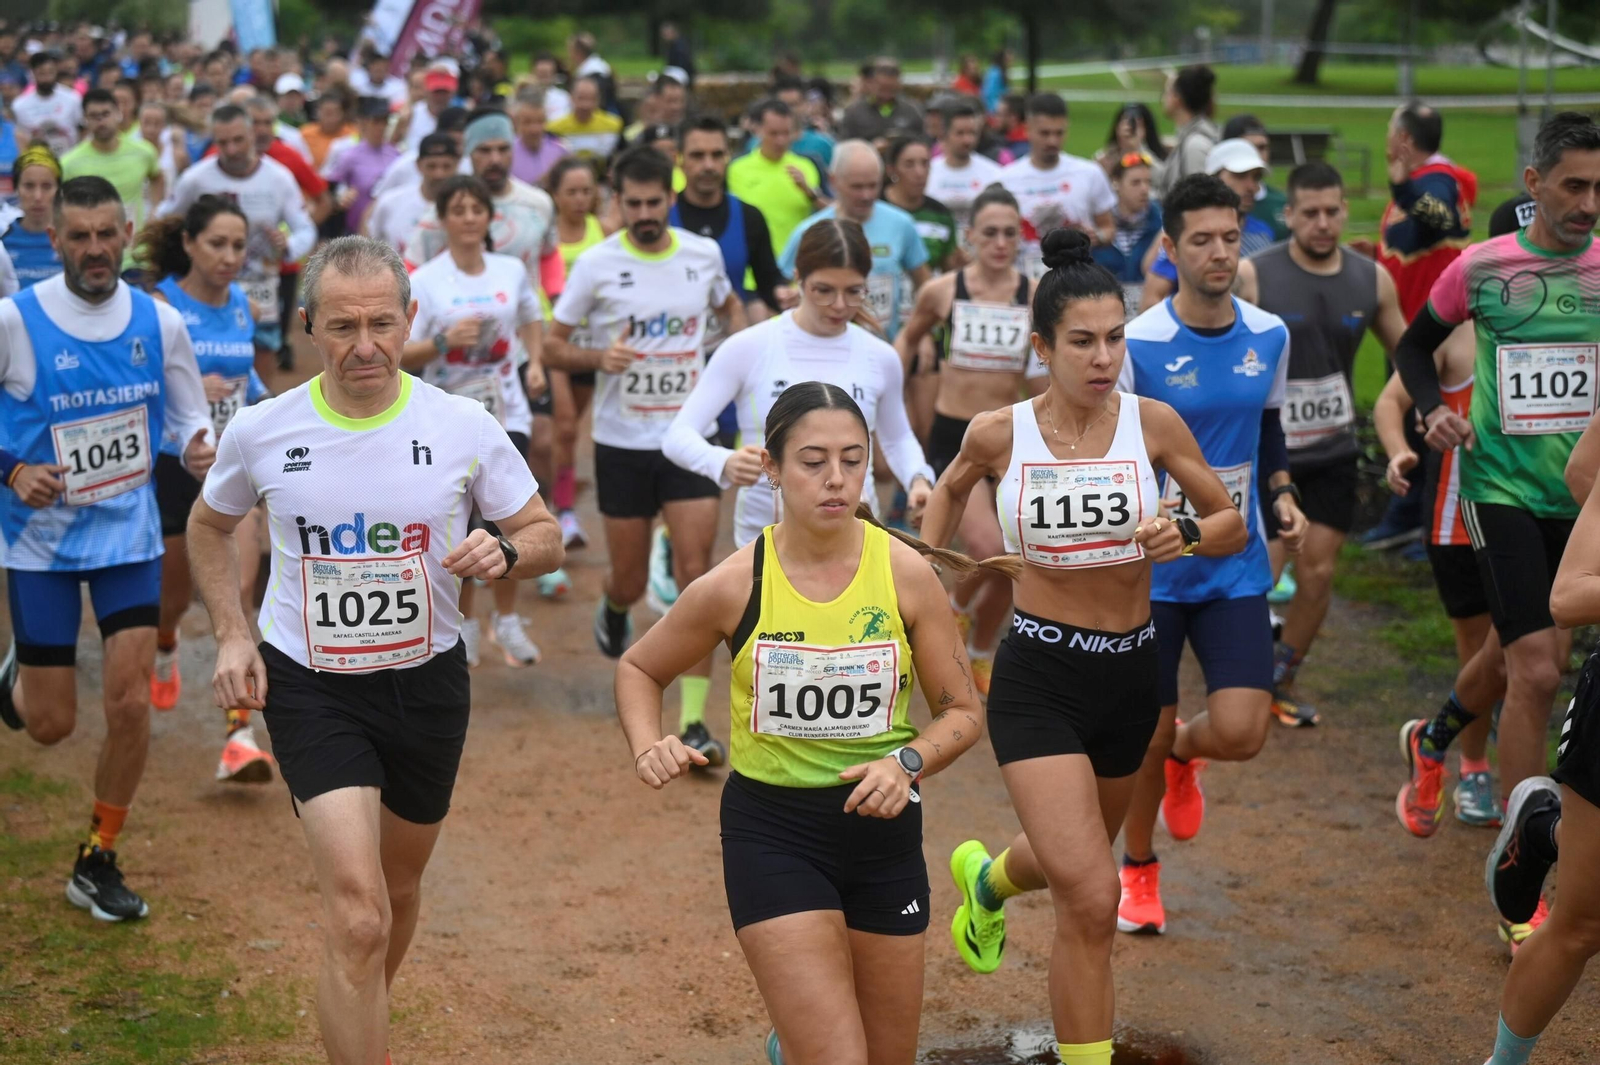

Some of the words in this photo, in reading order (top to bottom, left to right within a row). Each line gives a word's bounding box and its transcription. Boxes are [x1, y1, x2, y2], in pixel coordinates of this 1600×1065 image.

[629, 312, 699, 338] indea
[962, 323, 1021, 346] 1117
[49, 381, 160, 412] TROTASIERRA
[626, 372, 687, 394] 2162
[1509, 370, 1589, 400] 1102
[1286, 396, 1345, 423] 1062
[69, 433, 140, 476] 1043
[411, 439, 432, 465] in
[1030, 492, 1130, 529] 1153
[295, 512, 430, 555] indea
[315, 588, 420, 628] 1025
[848, 610, 860, 625] CLUB
[861, 606, 891, 620] ATLETISMO
[1013, 613, 1063, 643] PRO
[1068, 632, 1136, 653] NIKE
[767, 656, 804, 665] populares
[768, 651, 799, 660] carreras
[768, 682, 882, 722] 1005
[779, 723, 803, 731] CARMEN
[803, 723, 822, 732] MARÍA
